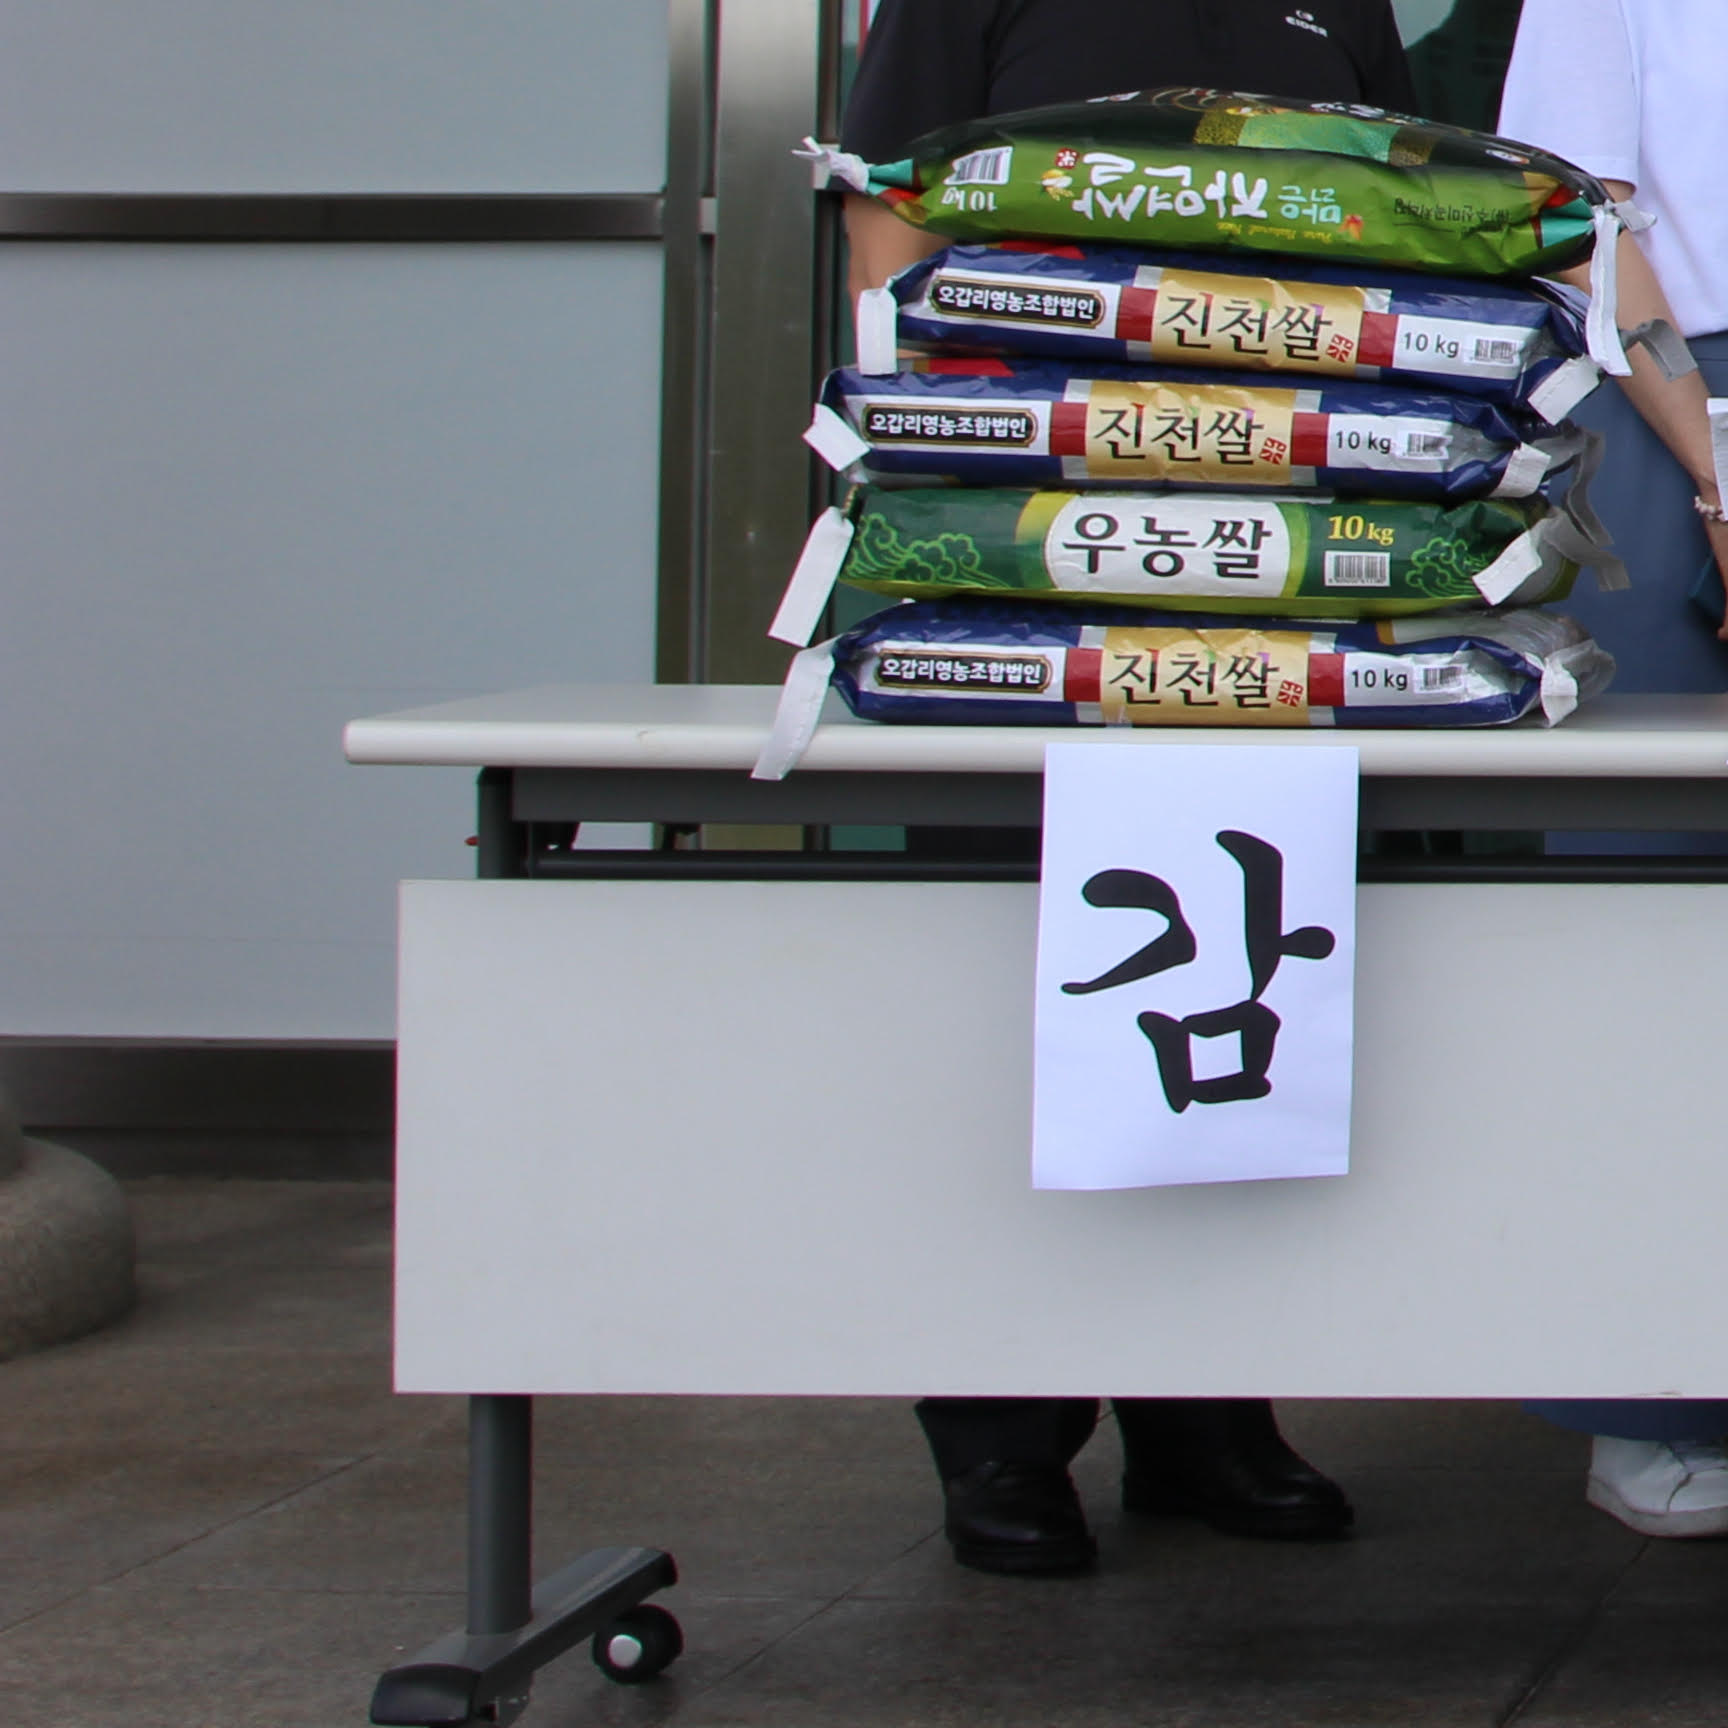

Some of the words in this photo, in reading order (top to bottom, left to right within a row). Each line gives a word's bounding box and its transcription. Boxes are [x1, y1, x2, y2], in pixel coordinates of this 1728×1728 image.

[1071, 153, 1268, 221] 자연쌀
[1277, 185, 1342, 223] 맑은
[938, 284, 1095, 319] 오갑리영농조합법인
[1161, 292, 1332, 361] 진천쌀
[1402, 332, 1428, 352] 10
[1435, 335, 1459, 358] kg
[870, 413, 1026, 438] 오갑리영농조합법인
[1094, 403, 1264, 466] 진천쌀
[1335, 431, 1361, 450] 10
[1368, 432, 1392, 455] kg
[1062, 513, 1272, 580] 우농쌀
[1327, 516, 1362, 539] 10
[1366, 522, 1395, 546] kg
[882, 658, 1041, 683] 오갑리영농조합법인
[1109, 648, 1280, 710] 진천쌀
[1351, 670, 1377, 688] 10
[1383, 671, 1408, 691] kg
[1061, 829, 1335, 1114] 감
